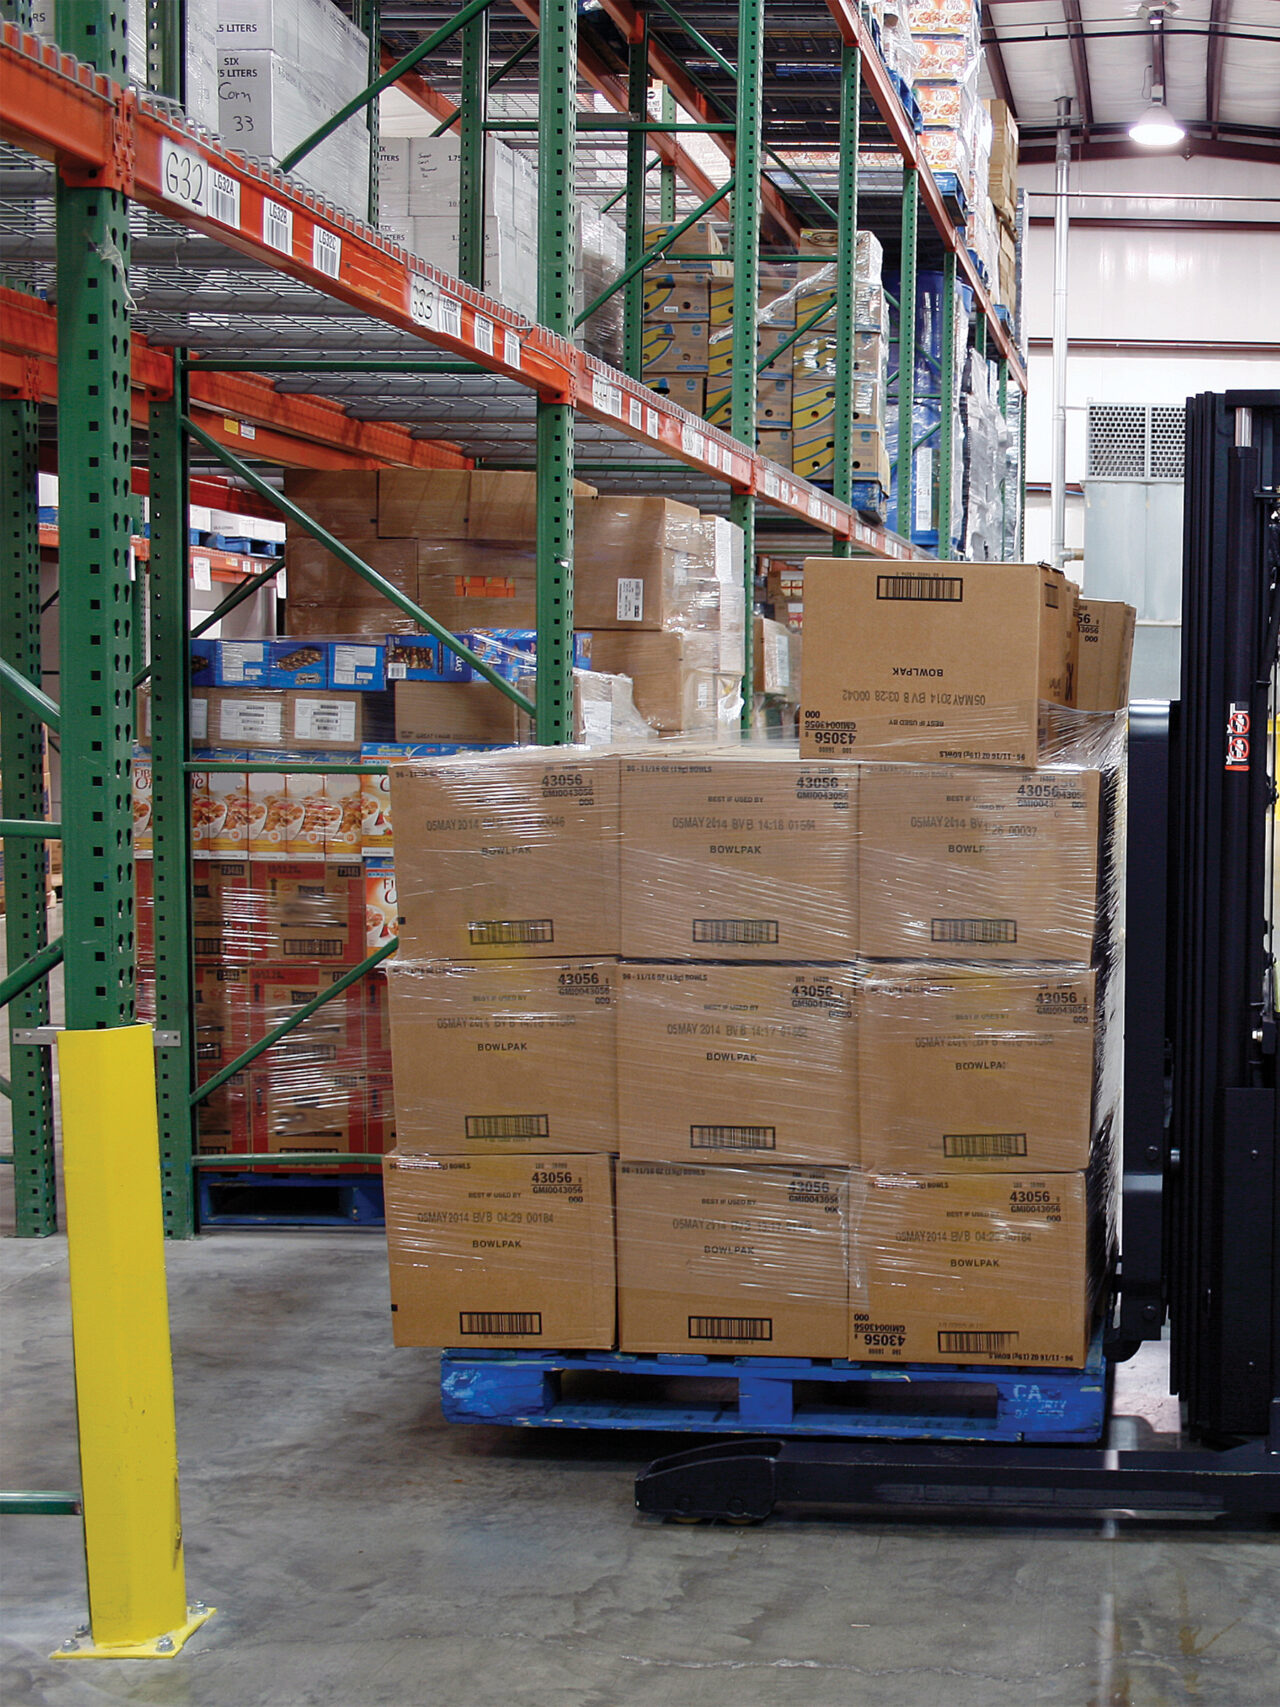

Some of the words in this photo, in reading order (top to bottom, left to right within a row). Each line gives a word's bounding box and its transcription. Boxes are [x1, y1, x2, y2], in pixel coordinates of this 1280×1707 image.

[226, 23, 257, 33] LITERS
[223, 57, 240, 66] SIX
[226, 68, 258, 78] LITERS
[232, 114, 255, 132] 33
[165, 151, 204, 207] G32
[213, 171, 235, 197] LG32A
[269, 201, 288, 225] LG32B
[318, 229, 337, 250] LG32C
[892, 667, 943, 677] BOWLPAK
[805, 710, 820, 719] 000
[899, 719, 917, 727] USED
[814, 732, 856, 744] 43056
[541, 774, 583, 788] 43056
[796, 777, 839, 790] 43056
[709, 845, 762, 854] BOWLPAK
[558, 973, 600, 985] 43056
[1035, 992, 1077, 1004] 43056
[477, 1042, 528, 1052] BOWLPAK
[706, 1052, 758, 1061] BOWLPAK
[531, 1172, 573, 1184] 43056
[532, 1186, 583, 1194] GMI0043056
[568, 1195, 584, 1204] 000
[1009, 1191, 1050, 1203] 43056
[496, 1211, 523, 1223] 04:29
[526, 1211, 554, 1224] 00184
[472, 1239, 522, 1249] BOWLPAK
[703, 1245, 755, 1255] BOWLPAK
[950, 1258, 1000, 1268] BOWLPAK
[854, 1313, 869, 1322] 000
[854, 1323, 906, 1332] GMI0043056
[864, 1334, 906, 1347] 43056
